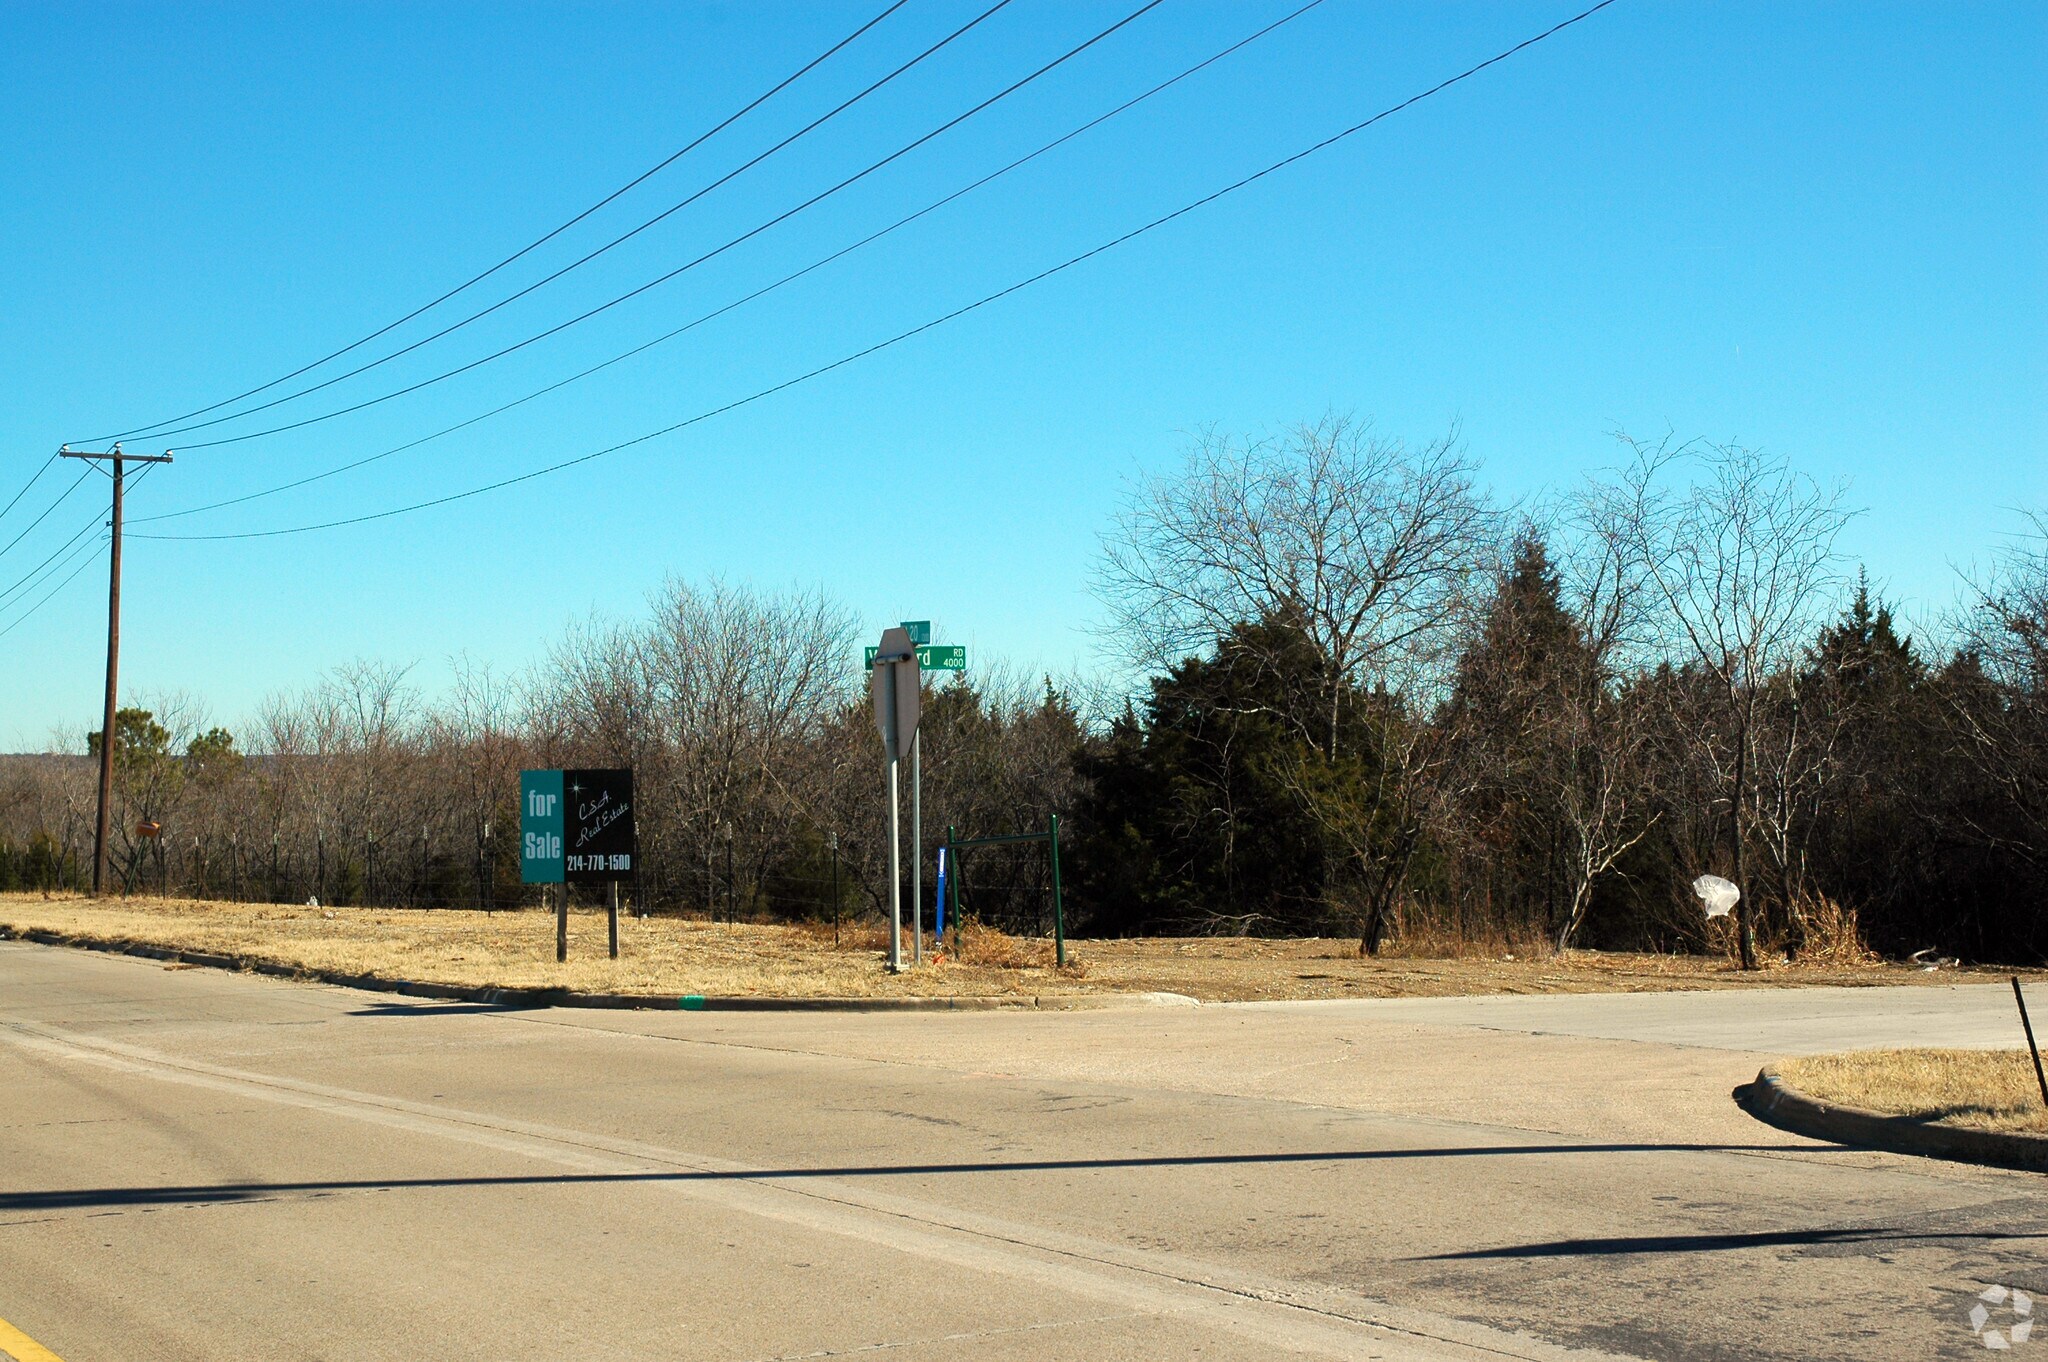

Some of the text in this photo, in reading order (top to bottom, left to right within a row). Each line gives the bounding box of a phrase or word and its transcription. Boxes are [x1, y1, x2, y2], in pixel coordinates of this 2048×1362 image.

[943, 658, 963, 667] 4000
[953, 648, 963, 657] RD
[529, 790, 556, 817] for
[576, 803, 629, 847] Real Estate
[525, 832, 561, 859] Sale
[567, 854, 630, 871] 214-770-1500
